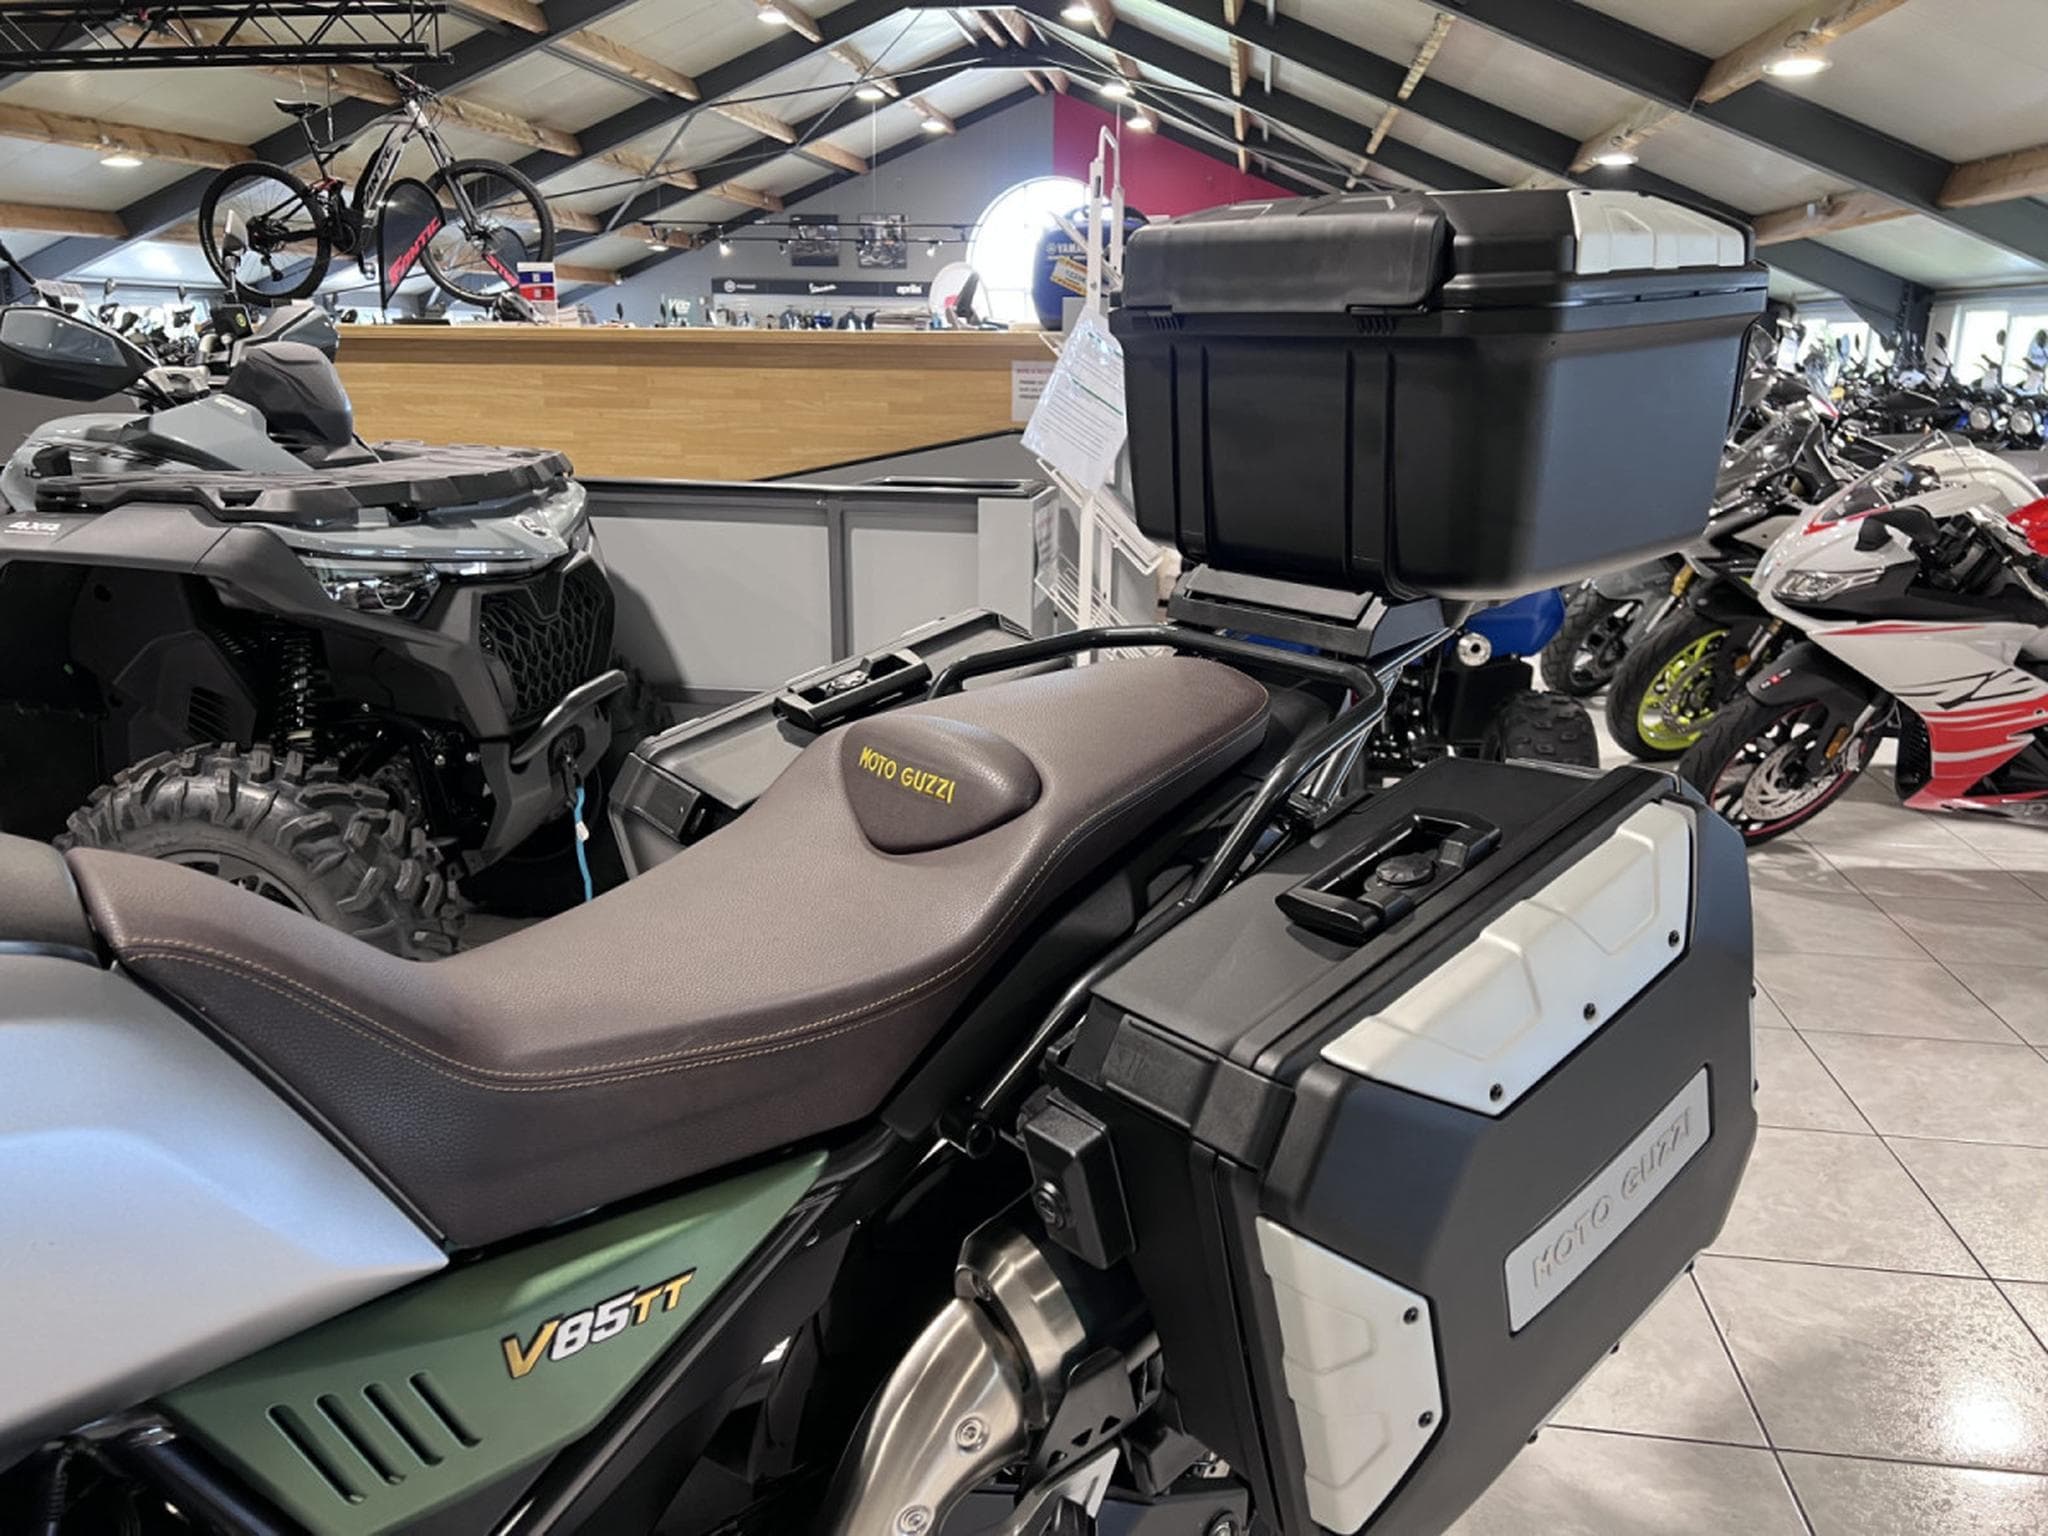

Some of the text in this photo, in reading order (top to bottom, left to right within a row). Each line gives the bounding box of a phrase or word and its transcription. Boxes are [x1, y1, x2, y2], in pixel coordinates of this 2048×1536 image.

[859, 746, 956, 804] MOTO GUZZI
[1532, 1106, 1692, 1288] MOTO GUZZI
[502, 1267, 697, 1379] V85TT
